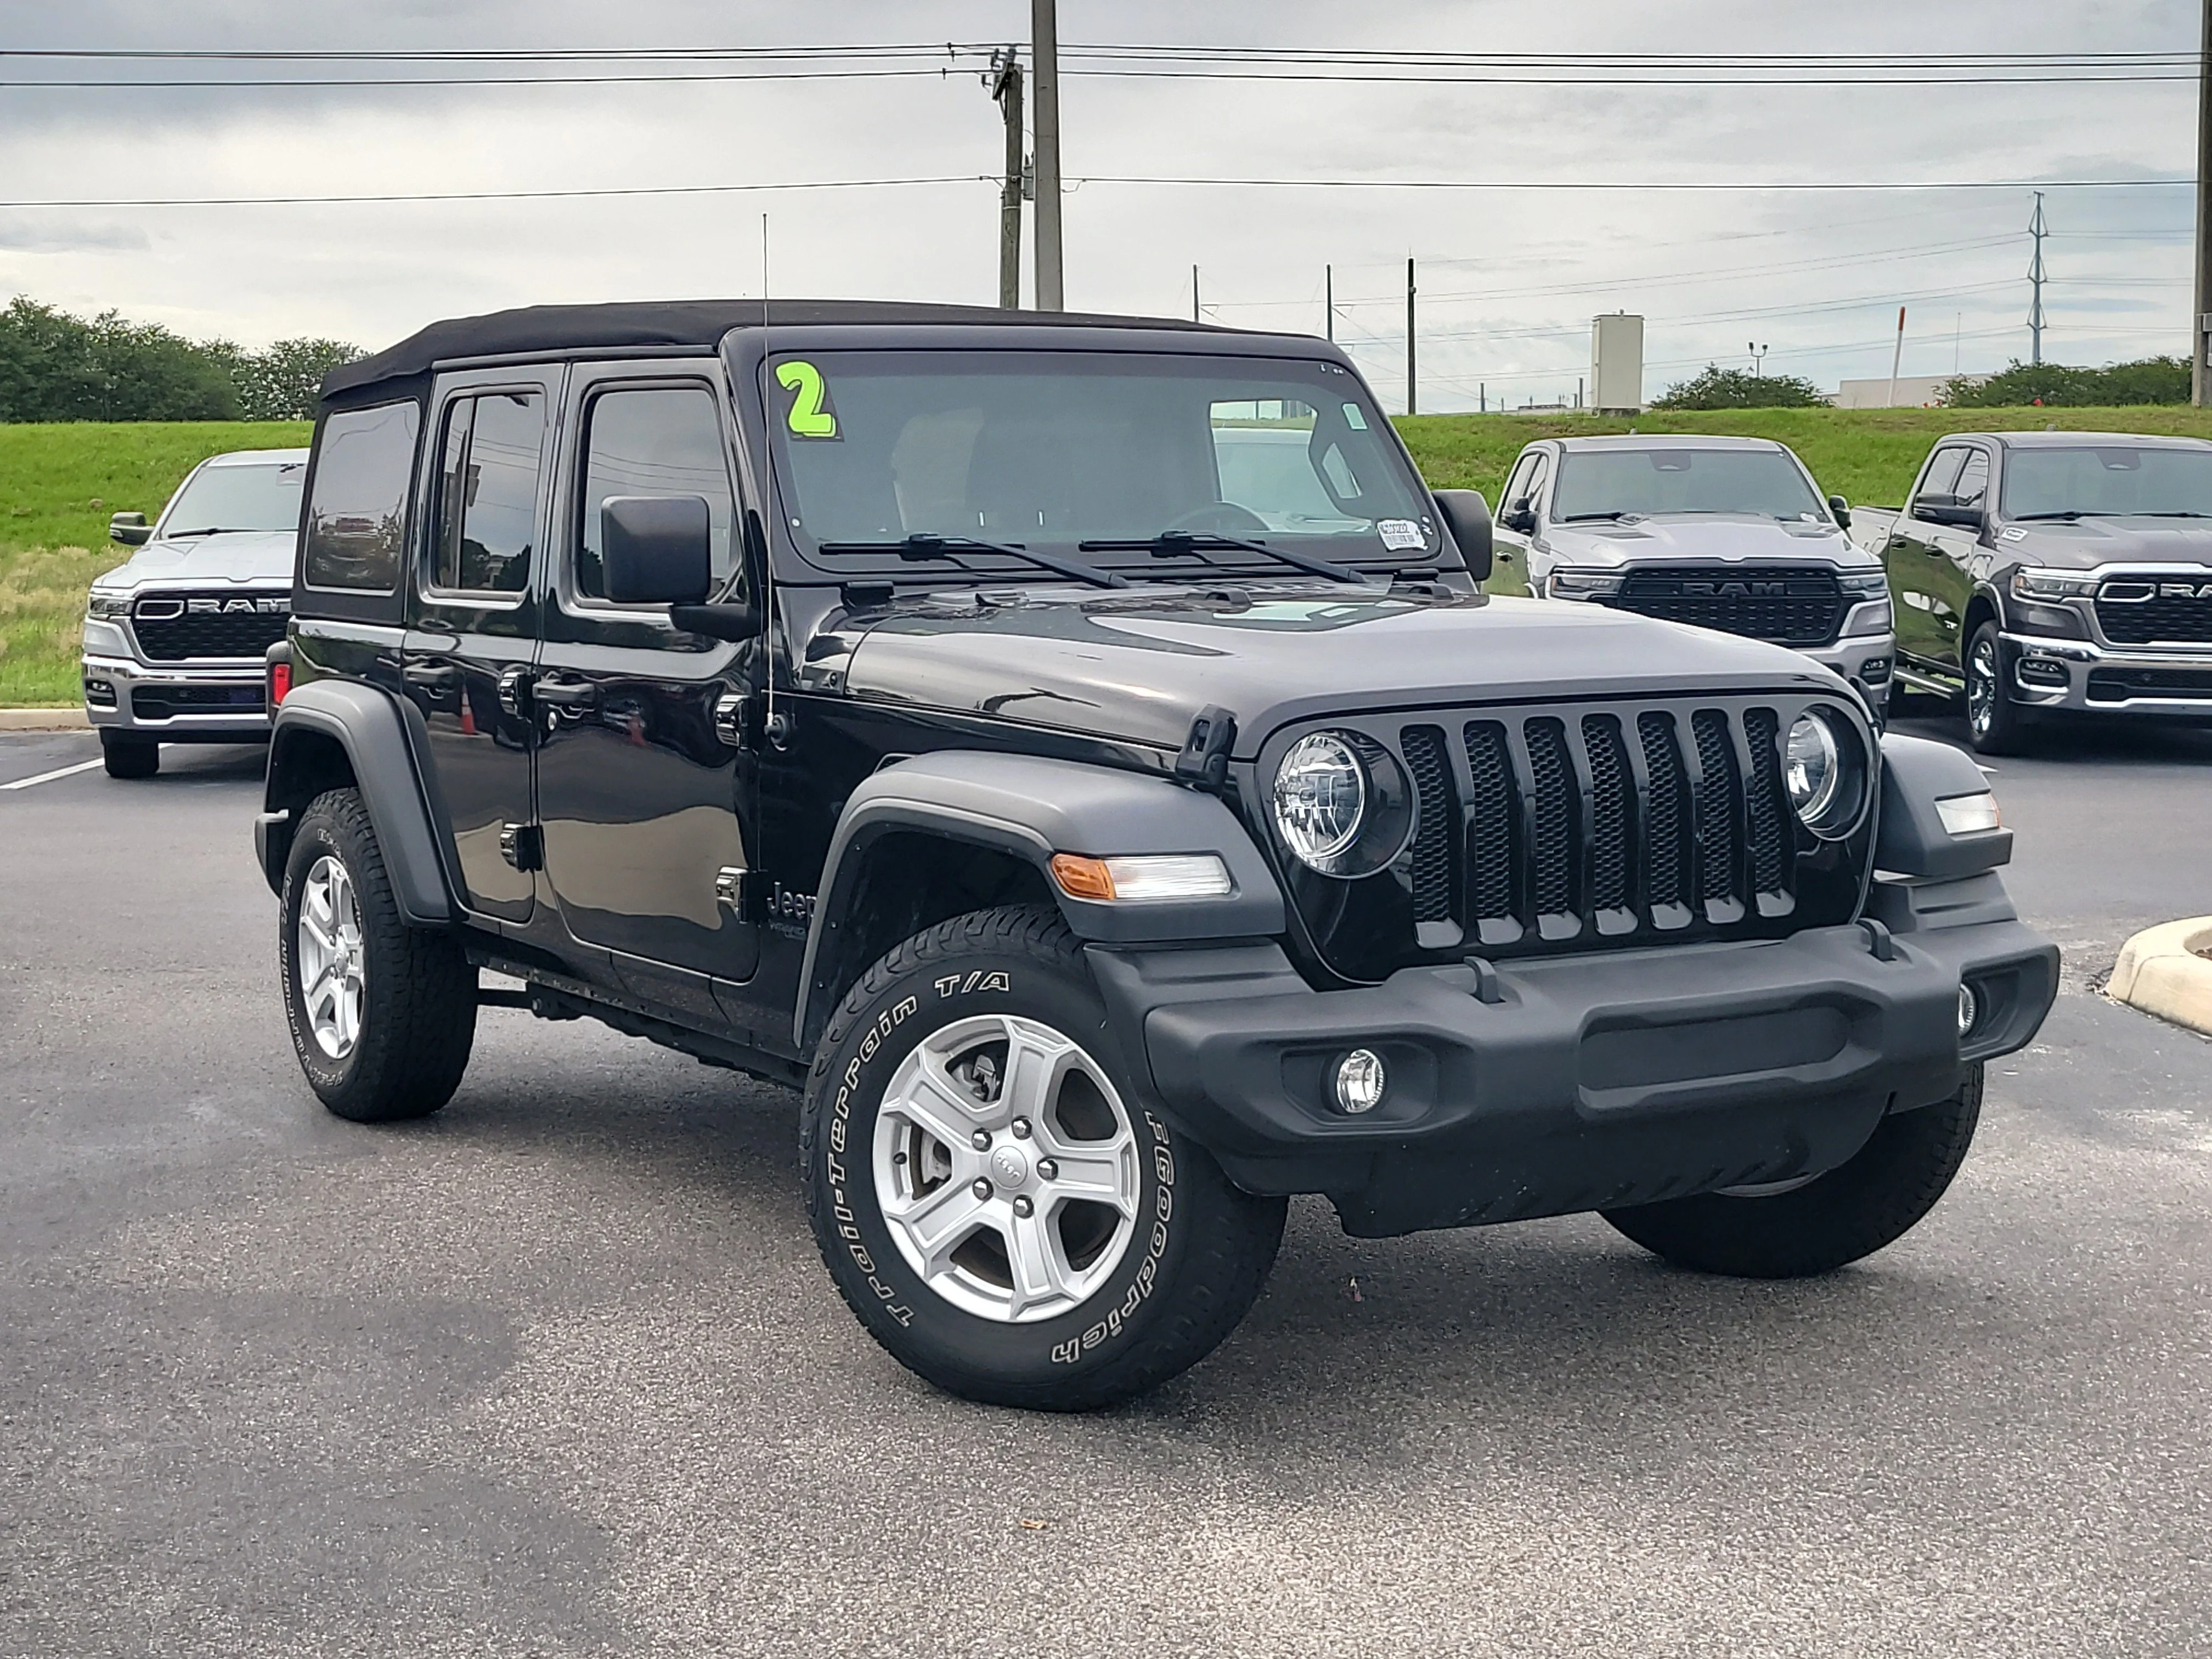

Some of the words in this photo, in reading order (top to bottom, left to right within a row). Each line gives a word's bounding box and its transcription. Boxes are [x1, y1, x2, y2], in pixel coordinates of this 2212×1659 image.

[775, 361, 836, 437] 2
[1683, 583, 1784, 595] RAM
[188, 599, 291, 613] RAM
[935, 971, 1009, 997] T/A
[1052, 1111, 1174, 1363] FGoodrich
